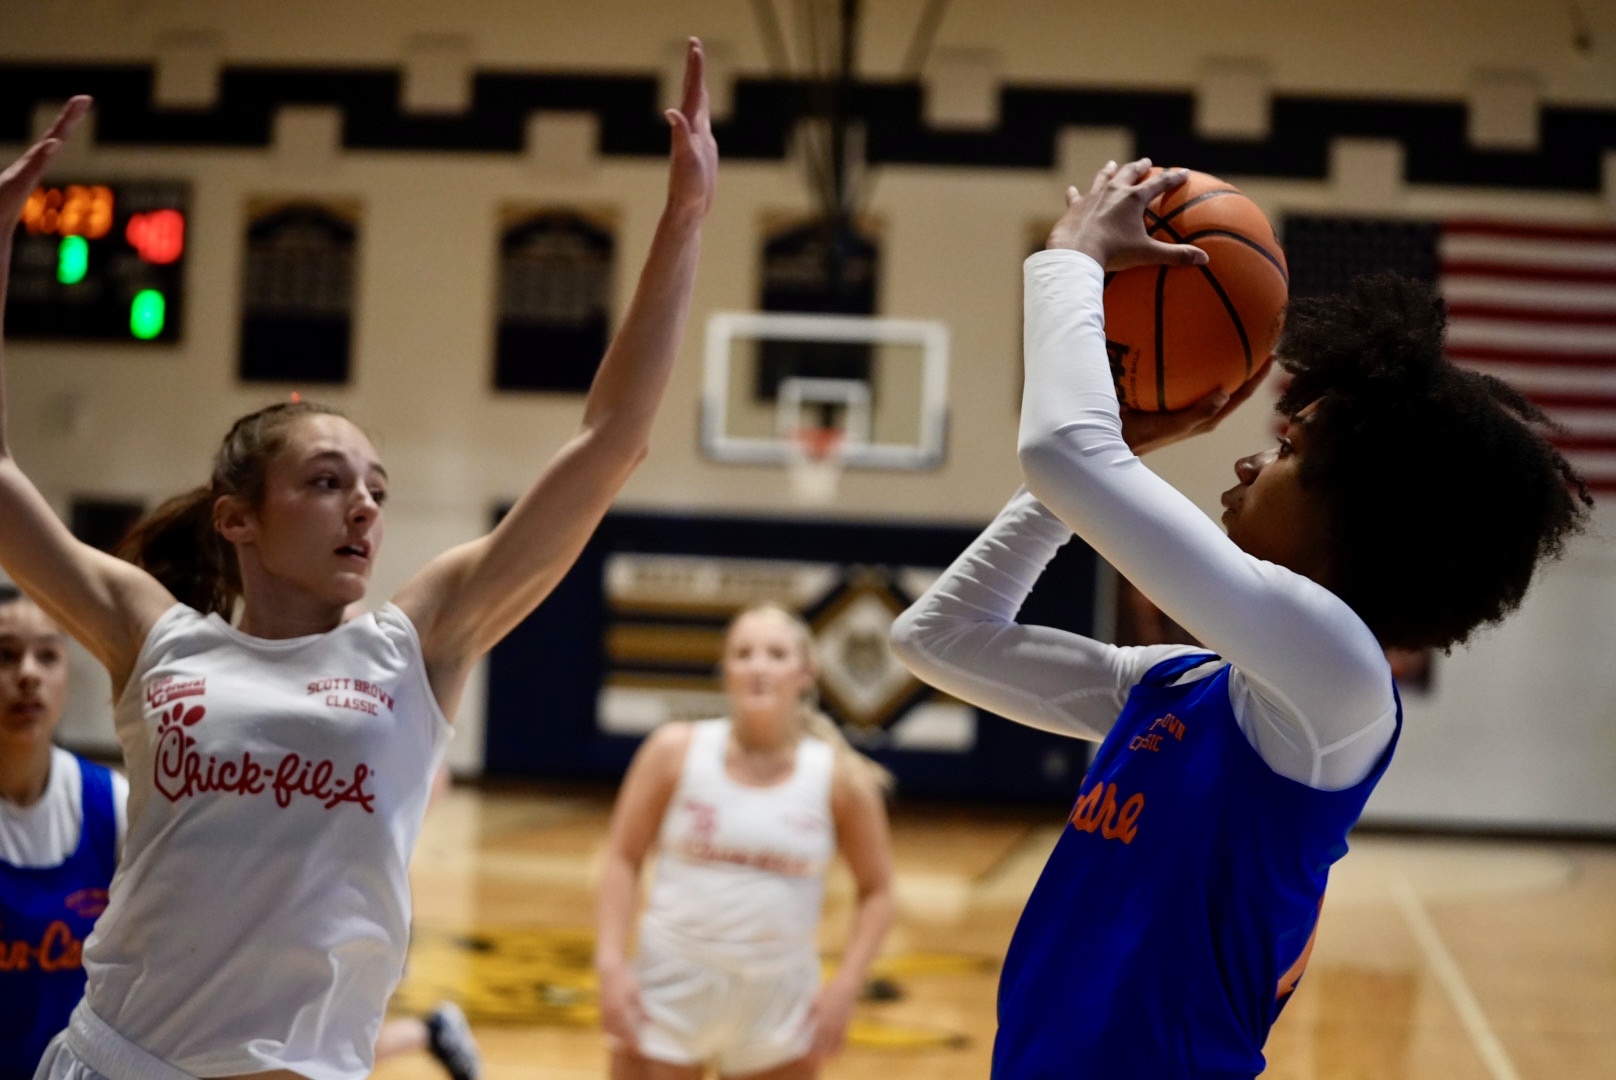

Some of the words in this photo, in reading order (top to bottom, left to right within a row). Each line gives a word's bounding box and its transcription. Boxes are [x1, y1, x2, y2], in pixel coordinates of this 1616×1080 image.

[306, 678, 351, 696] SCOTT
[353, 679, 395, 712] BROWN
[326, 694, 378, 717] CLASSIC
[154, 724, 376, 814] Chick-fil-A
[1070, 780, 1146, 845] are
